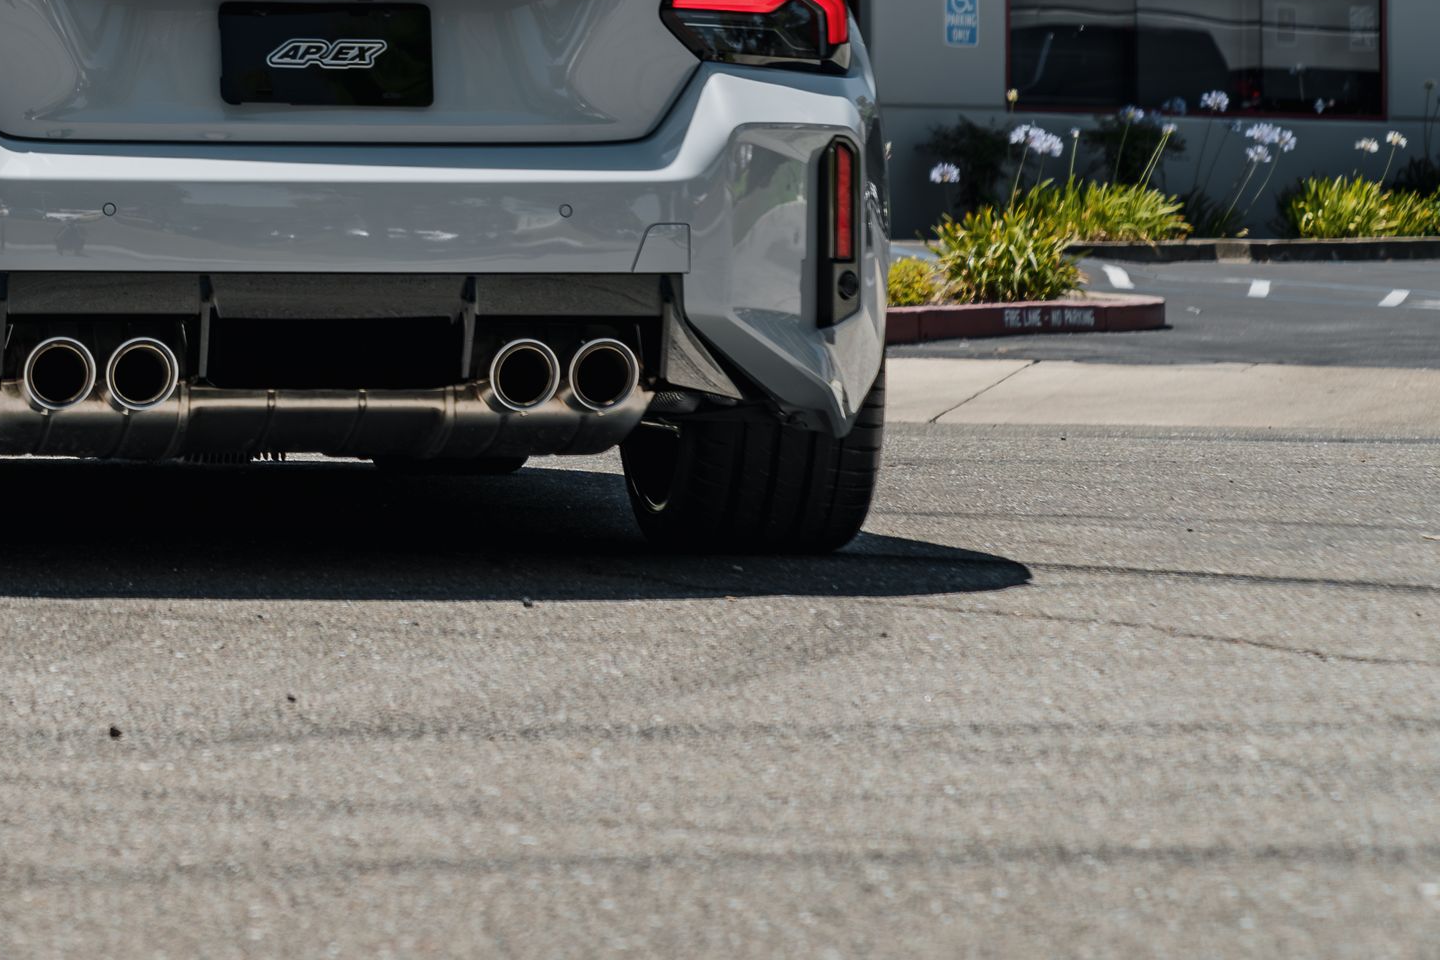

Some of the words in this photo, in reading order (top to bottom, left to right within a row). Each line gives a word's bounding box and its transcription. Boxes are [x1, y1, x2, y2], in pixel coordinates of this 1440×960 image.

[947, 14, 977, 27] PARKING
[952, 27, 971, 41] ONLY
[270, 40, 384, 67] APEX
[1004, 309, 1021, 328] FIRE
[1023, 309, 1042, 327] LANE
[1051, 309, 1062, 327] NO
[1064, 309, 1095, 327] PARKING
